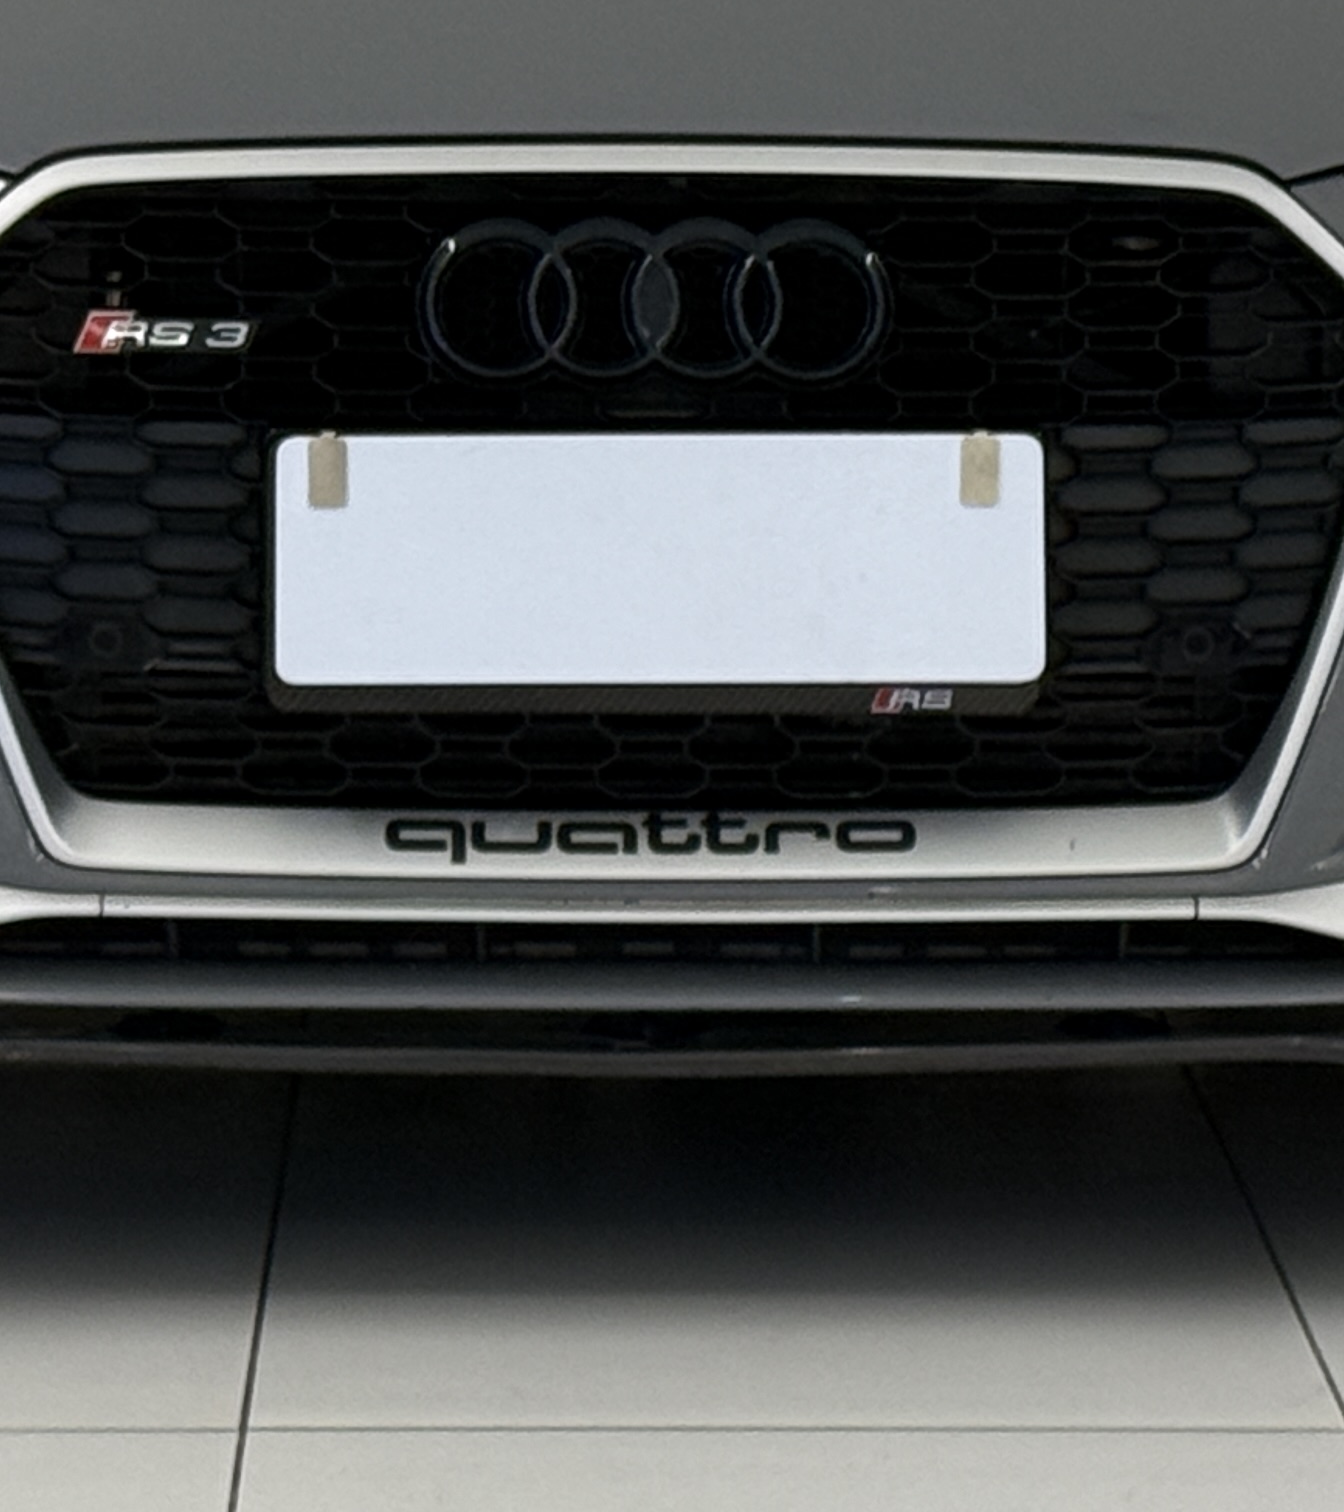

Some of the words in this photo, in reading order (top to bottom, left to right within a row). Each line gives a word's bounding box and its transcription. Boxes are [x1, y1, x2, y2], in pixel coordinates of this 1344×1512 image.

[90, 315, 194, 351] RS
[205, 321, 250, 348] 3
[881, 687, 953, 712] RS
[384, 812, 917, 864] quattro
